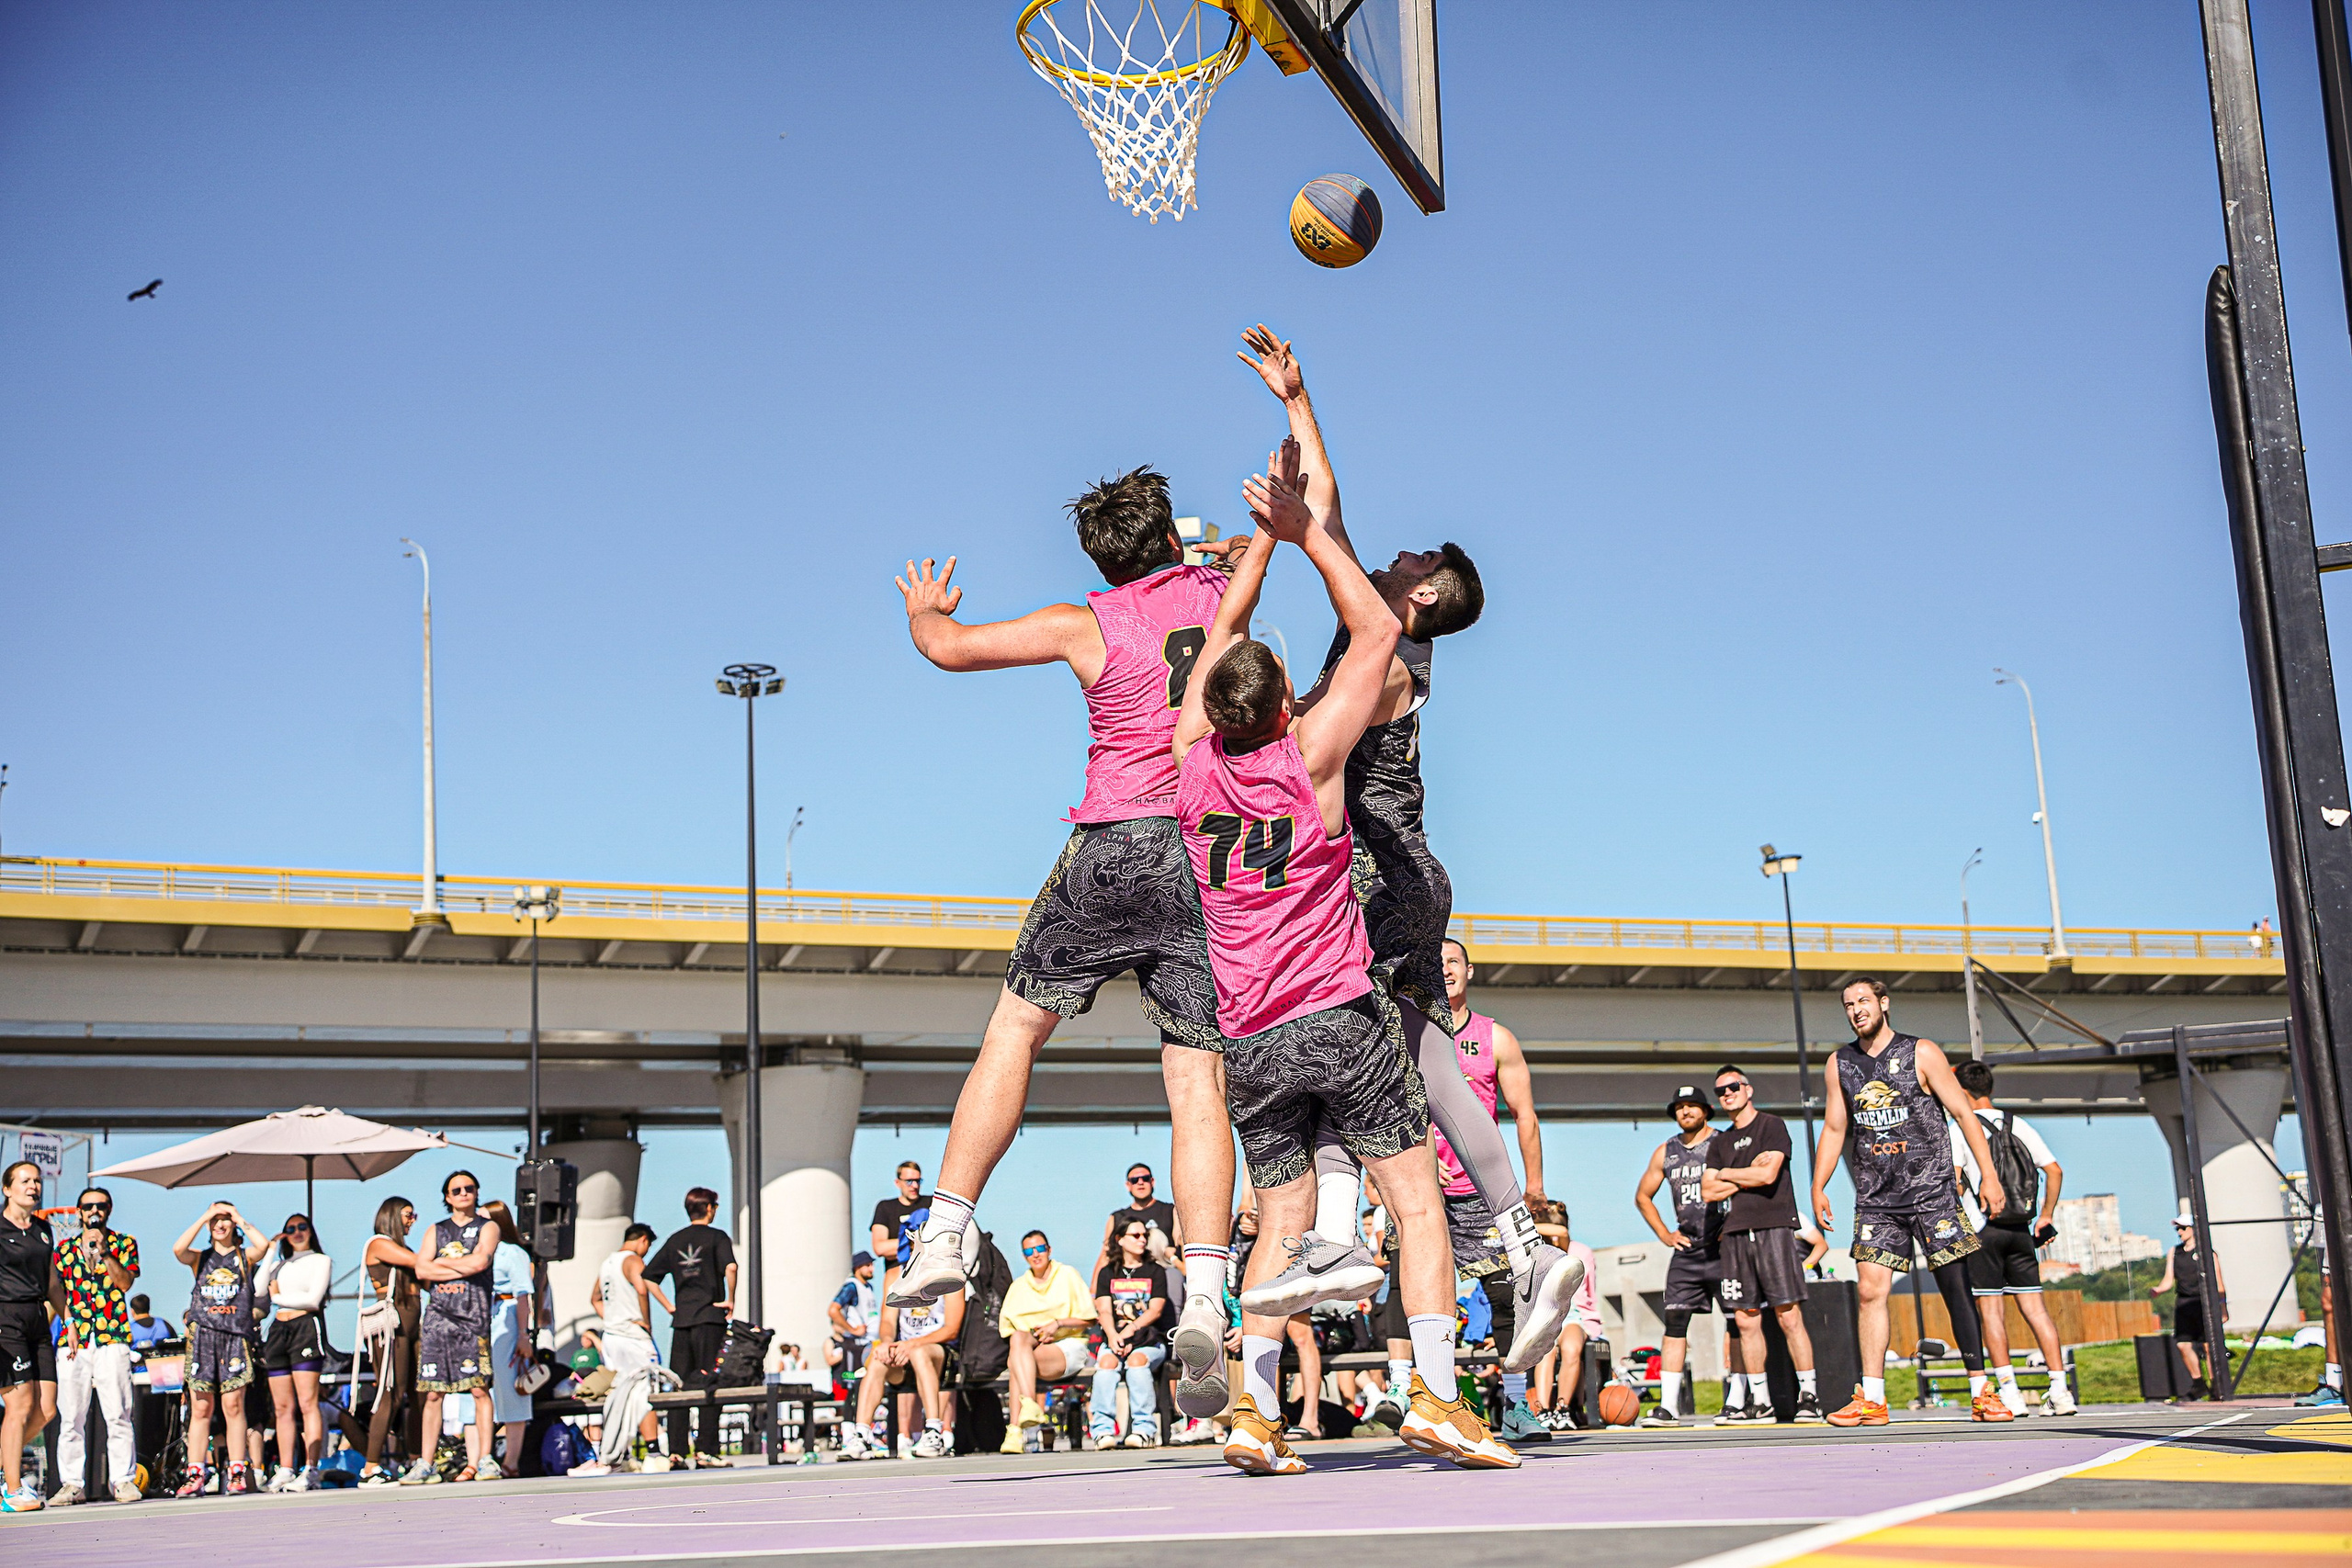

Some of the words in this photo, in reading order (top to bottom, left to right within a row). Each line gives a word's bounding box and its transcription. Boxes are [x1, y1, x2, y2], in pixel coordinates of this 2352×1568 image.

[1101, 831, 1130, 842] ALPHA
[1197, 810, 1296, 892] 74
[1460, 1040, 1479, 1055] 45
[1889, 1058, 1900, 1075] 5
[1853, 1107, 1909, 1127] KREMLIN
[1680, 1183, 1702, 1204] 24
[1860, 1224, 1873, 1240] 5
